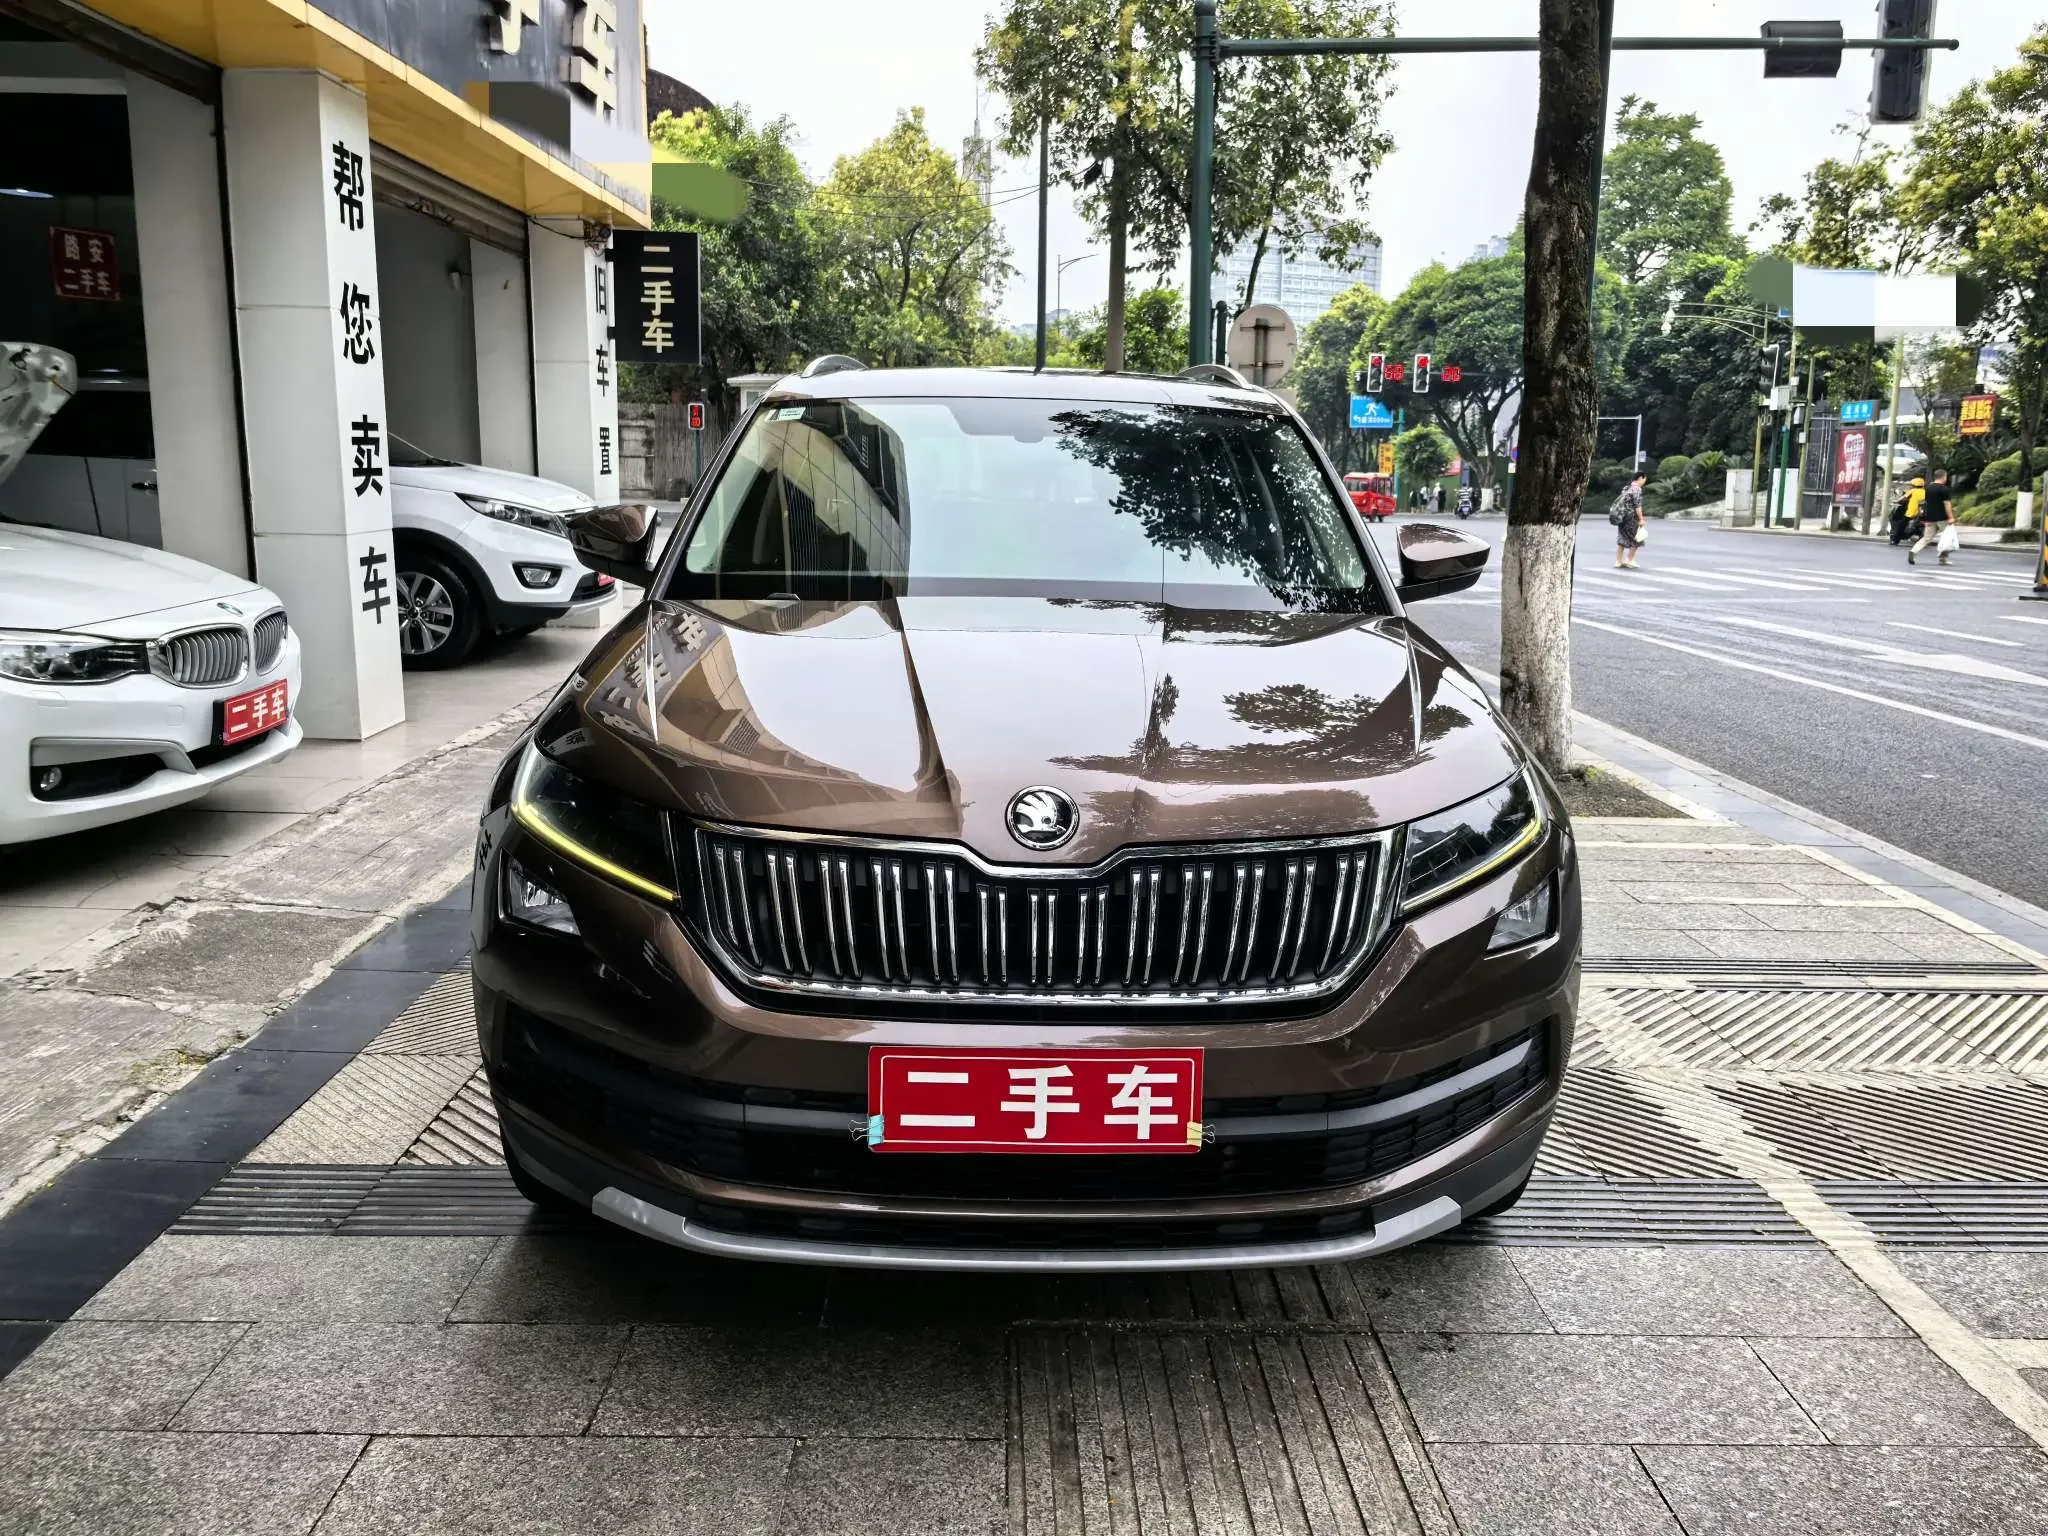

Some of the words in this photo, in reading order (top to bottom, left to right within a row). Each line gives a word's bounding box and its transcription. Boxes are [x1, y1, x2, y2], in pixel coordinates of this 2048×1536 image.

[63, 268, 111, 295] 二手车
[640, 246, 675, 354] 二手车
[332, 140, 391, 625] 帮您卖车
[230, 688, 285, 733] 二手车
[900, 1064, 1179, 1140] 二手车
